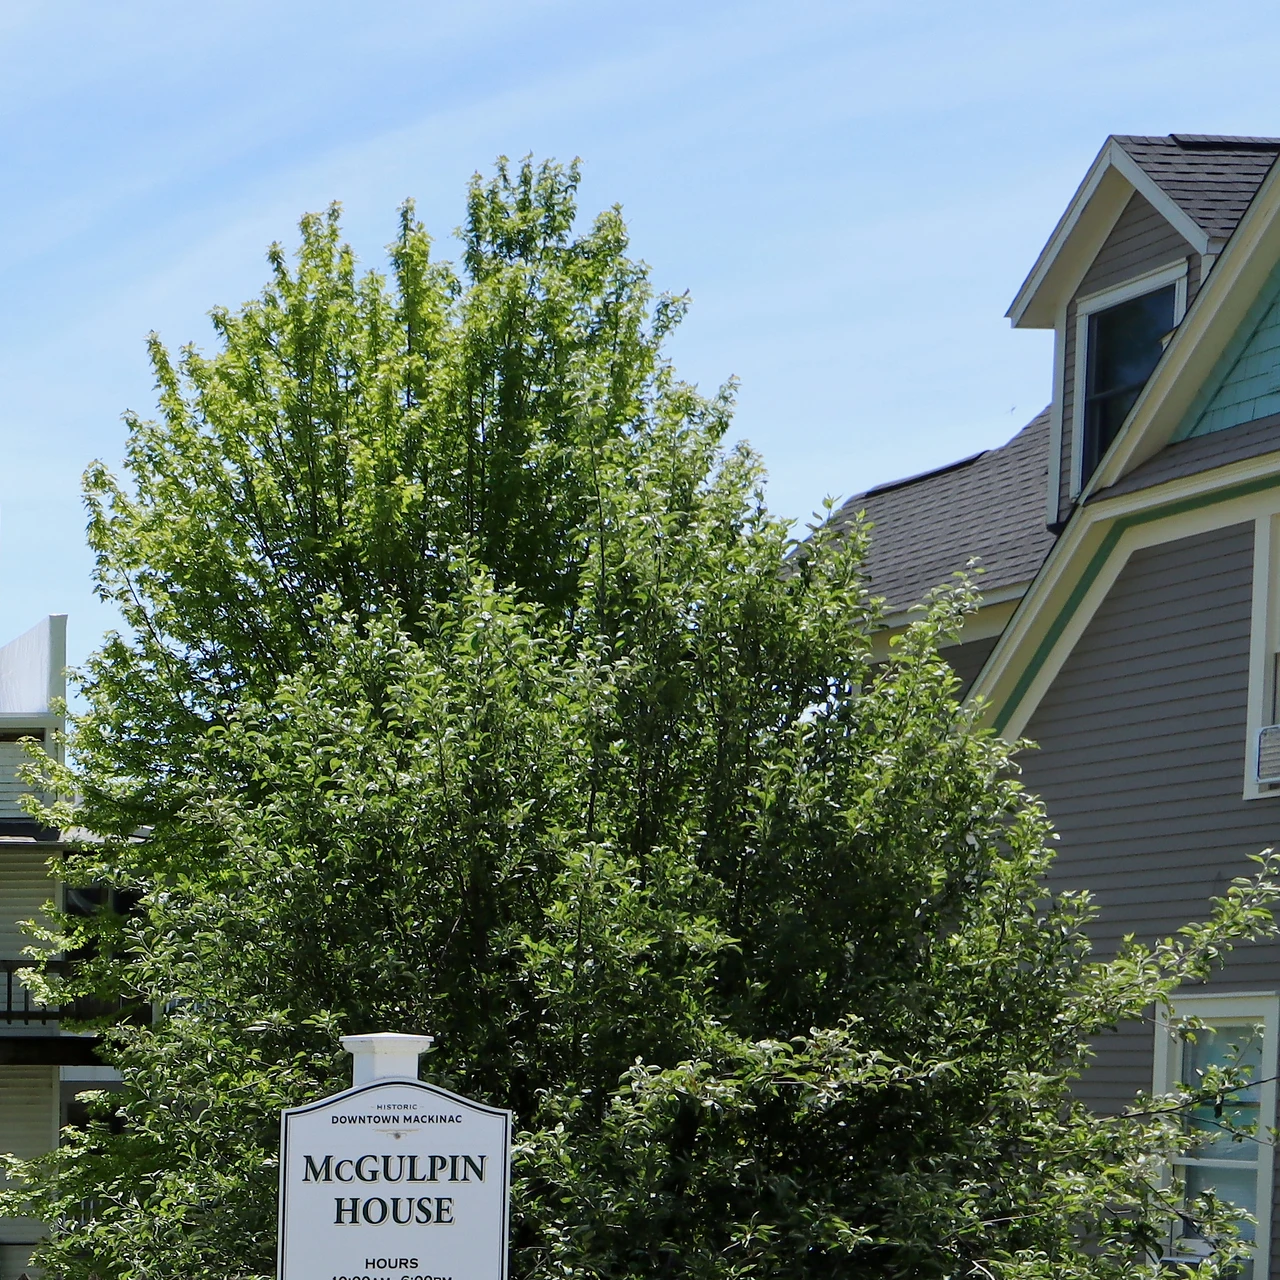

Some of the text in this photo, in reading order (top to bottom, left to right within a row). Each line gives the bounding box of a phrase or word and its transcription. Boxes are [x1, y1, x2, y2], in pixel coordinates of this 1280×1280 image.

[376, 1103, 418, 1111] HISTORIC
[331, 1114, 463, 1125] DOWNTOWN MACKINAC
[332, 1196, 455, 1227] HOUSE
[364, 1257, 419, 1270] HOURS
